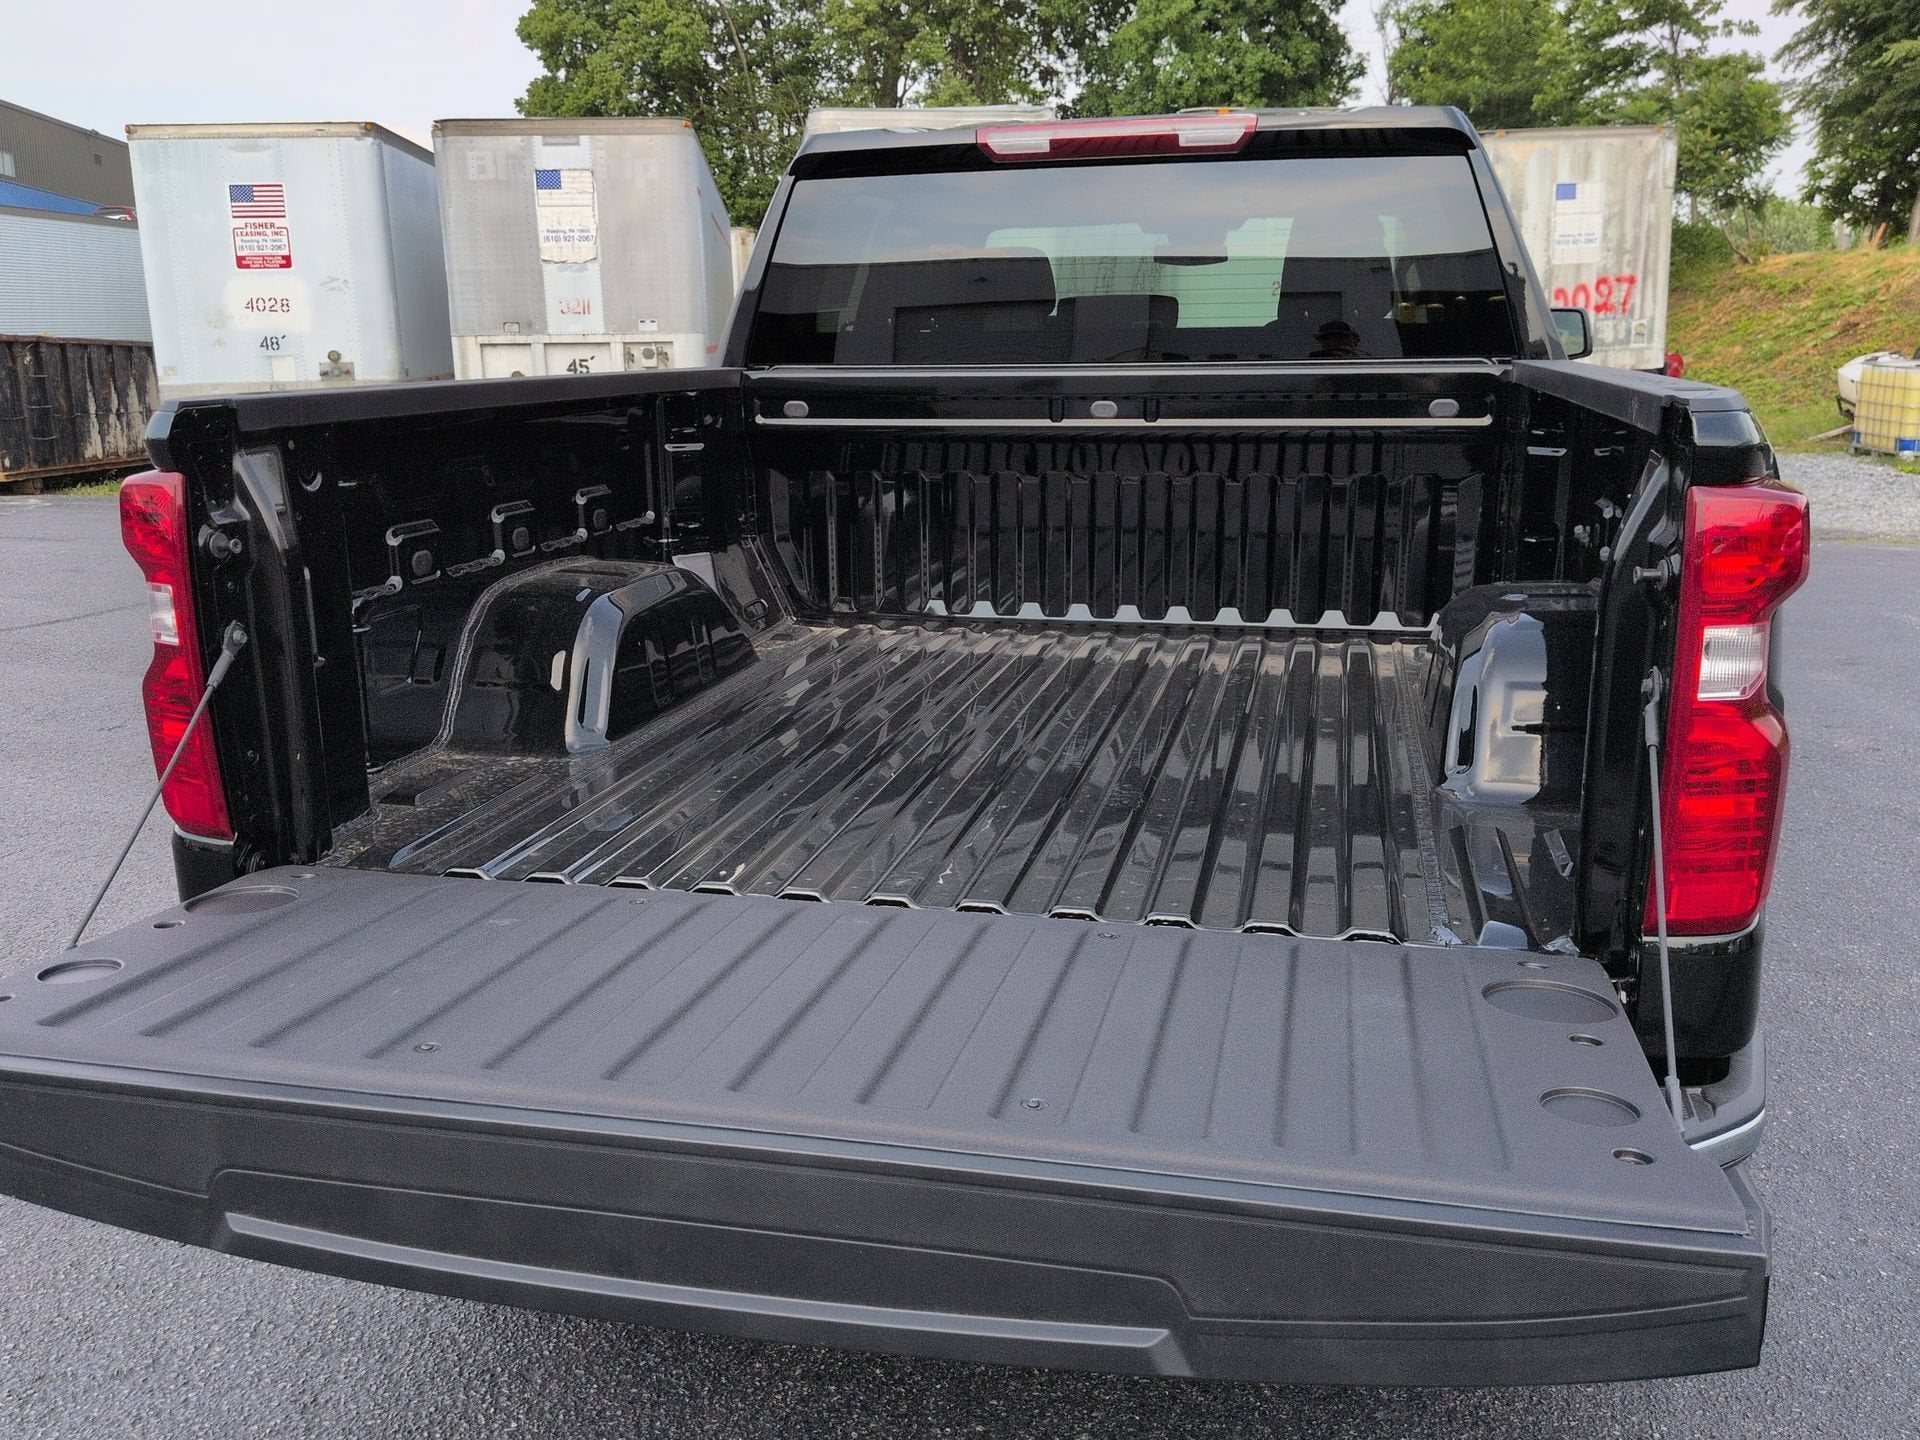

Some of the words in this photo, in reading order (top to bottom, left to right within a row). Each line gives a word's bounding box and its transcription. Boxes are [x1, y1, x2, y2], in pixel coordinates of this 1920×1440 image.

[244, 222, 276, 230] FISHER
[244, 297, 290, 313] 4028
[559, 299, 591, 315] 3211
